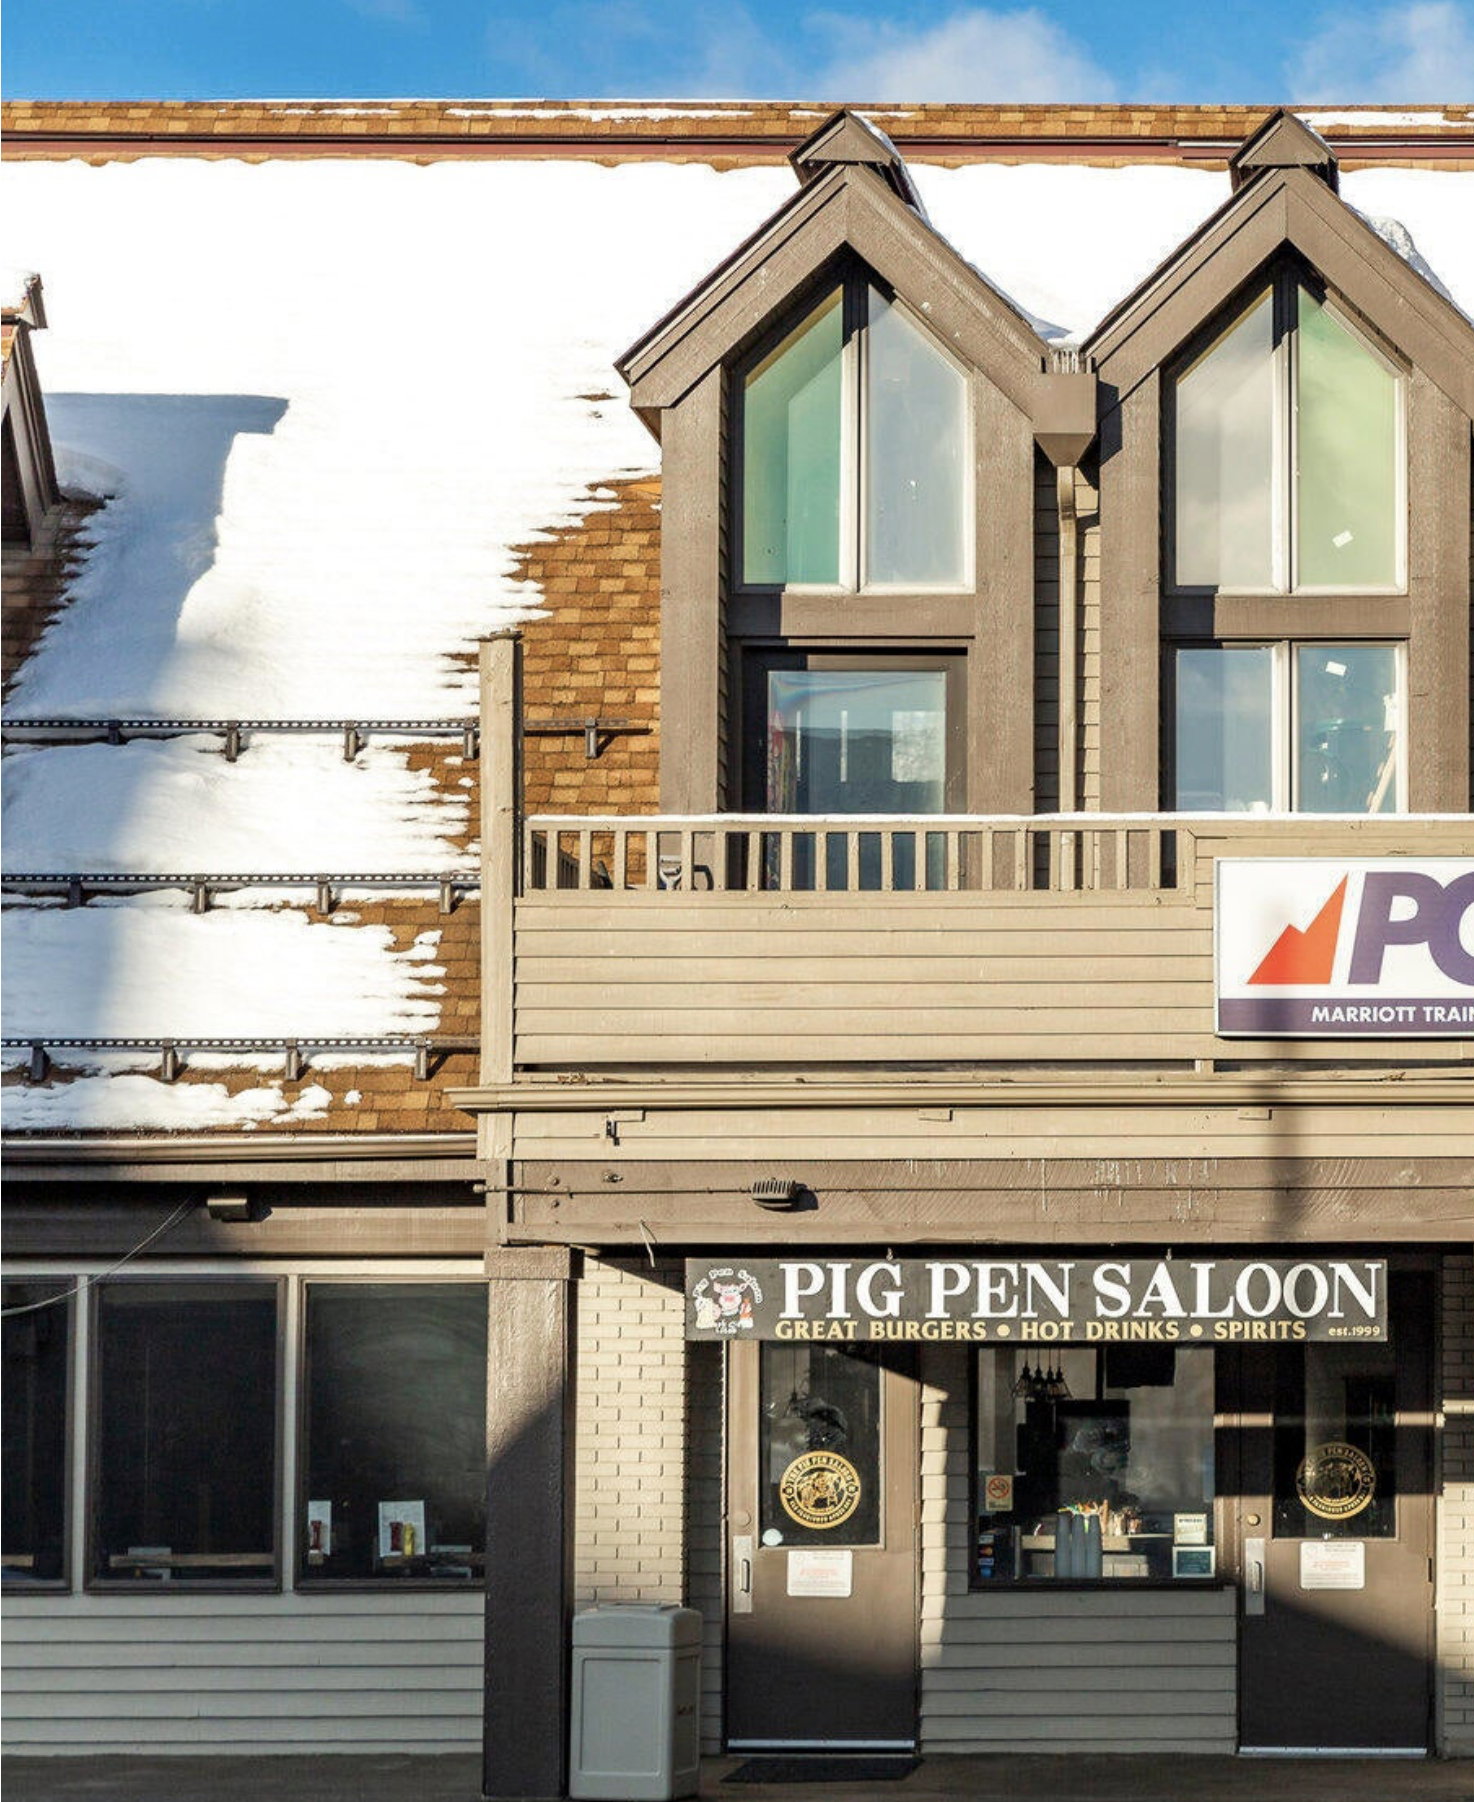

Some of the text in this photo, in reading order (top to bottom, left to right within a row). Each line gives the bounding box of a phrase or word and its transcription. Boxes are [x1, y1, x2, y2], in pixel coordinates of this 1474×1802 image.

[1311, 1006, 1416, 1023] MARRIOTT
[778, 1262, 1382, 1319] PIG PEN SALOON
[775, 1321, 1307, 1340] GREAT BURGERS HOT DRINKS SPIRITS
